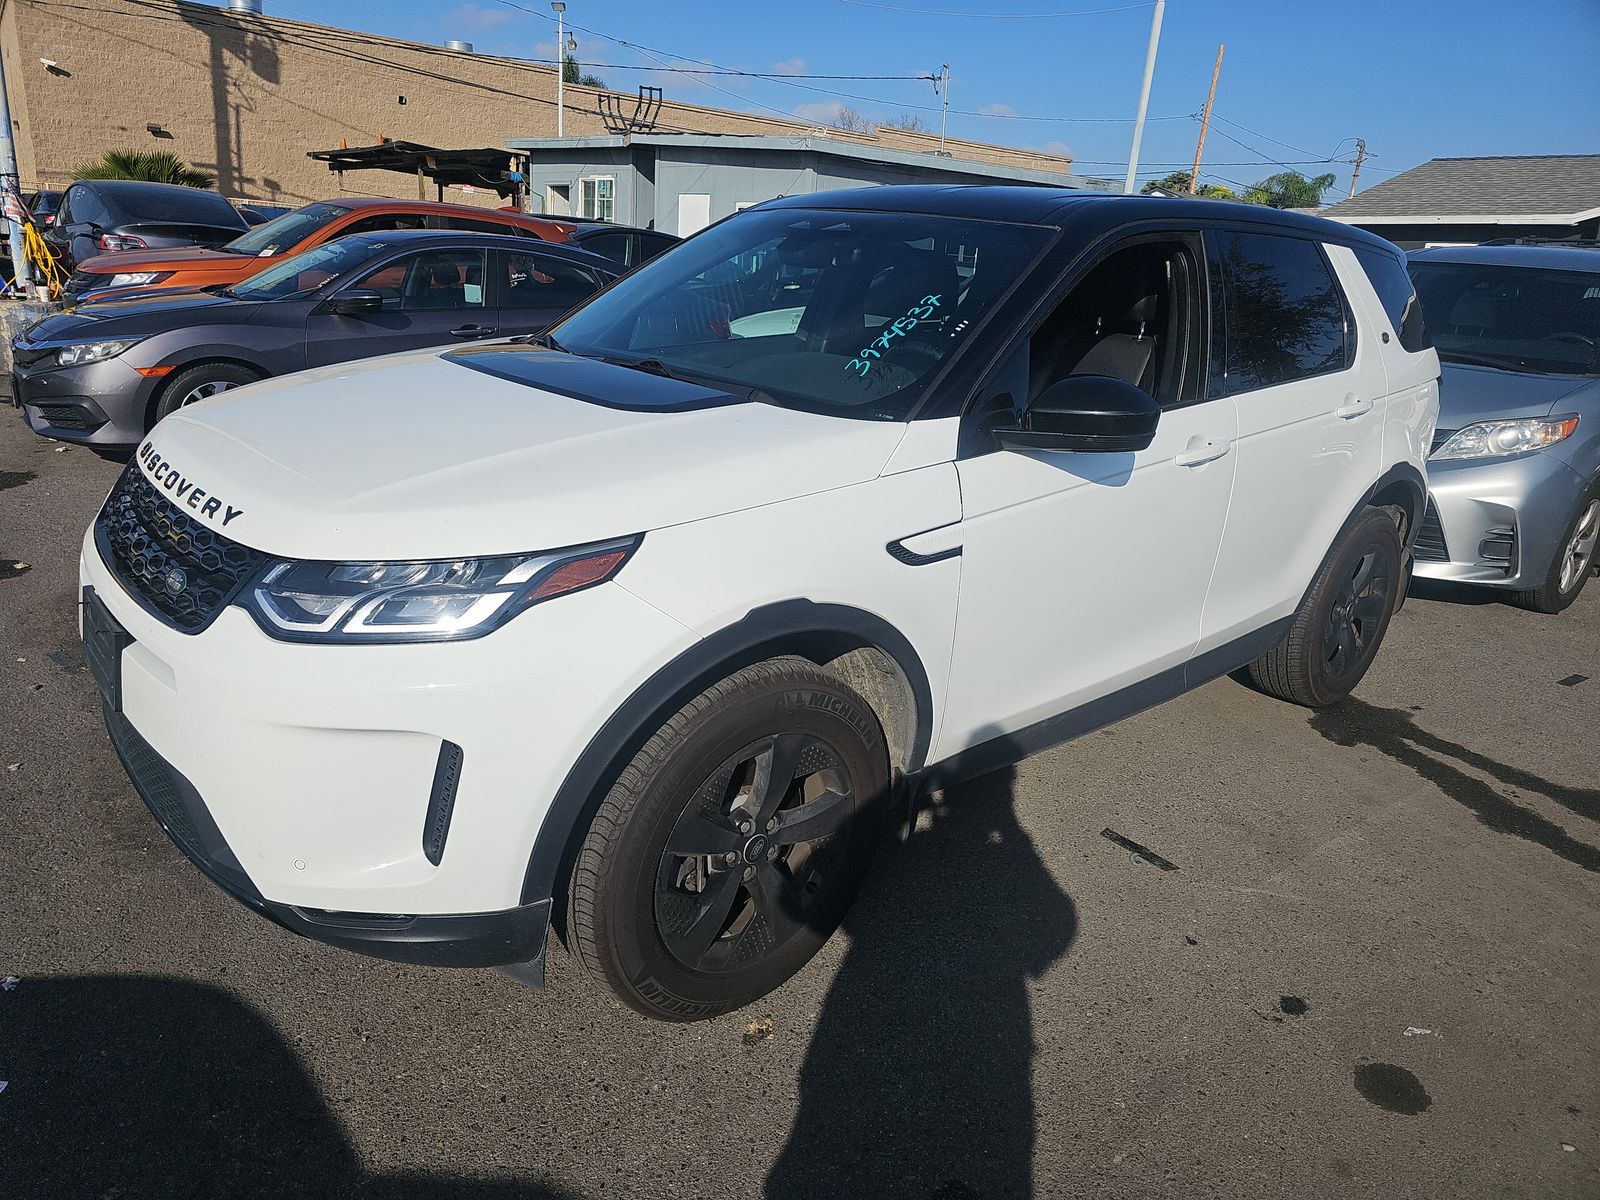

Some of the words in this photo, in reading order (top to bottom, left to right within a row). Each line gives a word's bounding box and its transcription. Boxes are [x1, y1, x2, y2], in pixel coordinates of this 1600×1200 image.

[844, 294, 942, 377] 3974537
[140, 441, 244, 526] DISCOVERY
[807, 692, 876, 747] MICHELIN
